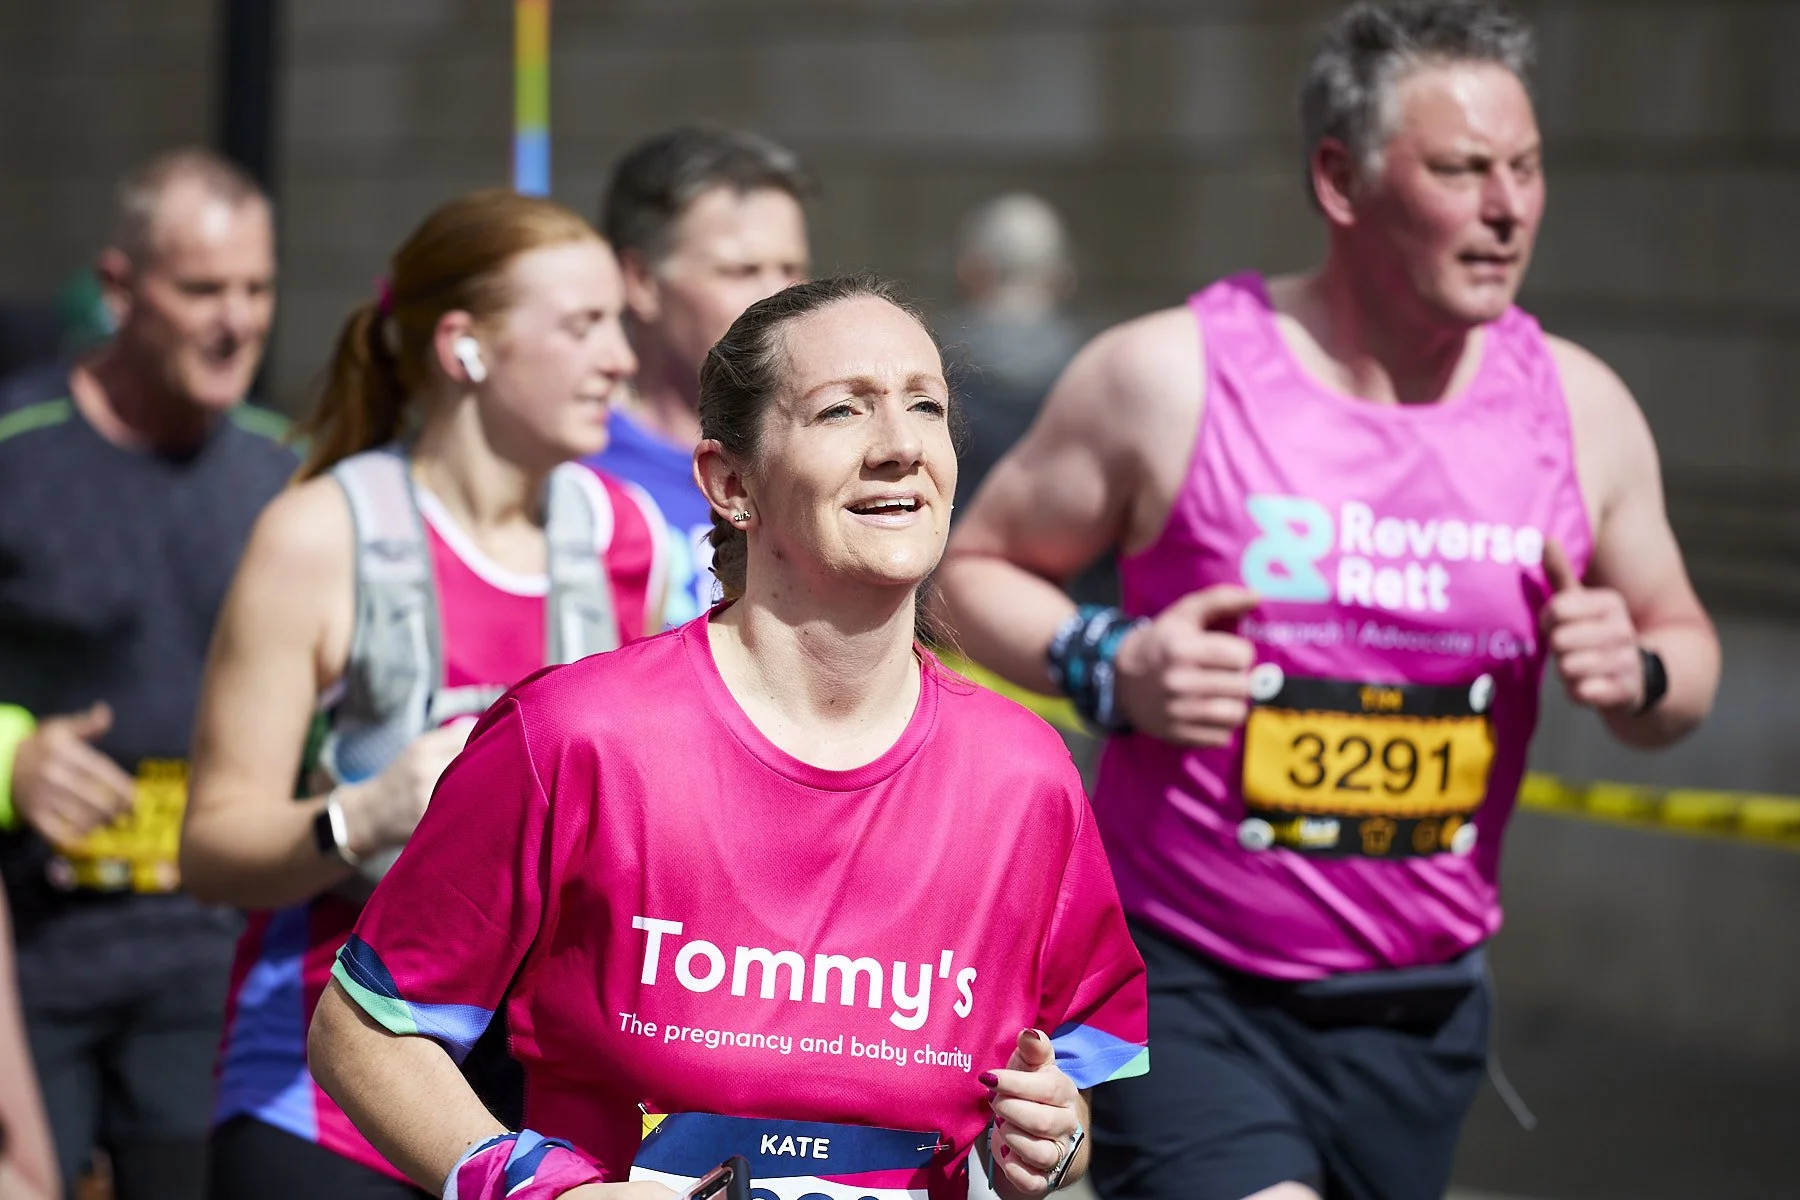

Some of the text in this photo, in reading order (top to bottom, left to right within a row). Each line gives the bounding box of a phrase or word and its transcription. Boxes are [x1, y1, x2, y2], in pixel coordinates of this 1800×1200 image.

[1338, 501, 1545, 566] Reverse
[1336, 556, 1451, 613] Rett
[1286, 732, 1455, 797] 3291
[631, 915, 978, 1031] Tommy's
[618, 1012, 973, 1073] The pregnancy and baby charity
[760, 1133, 831, 1160] KATE
